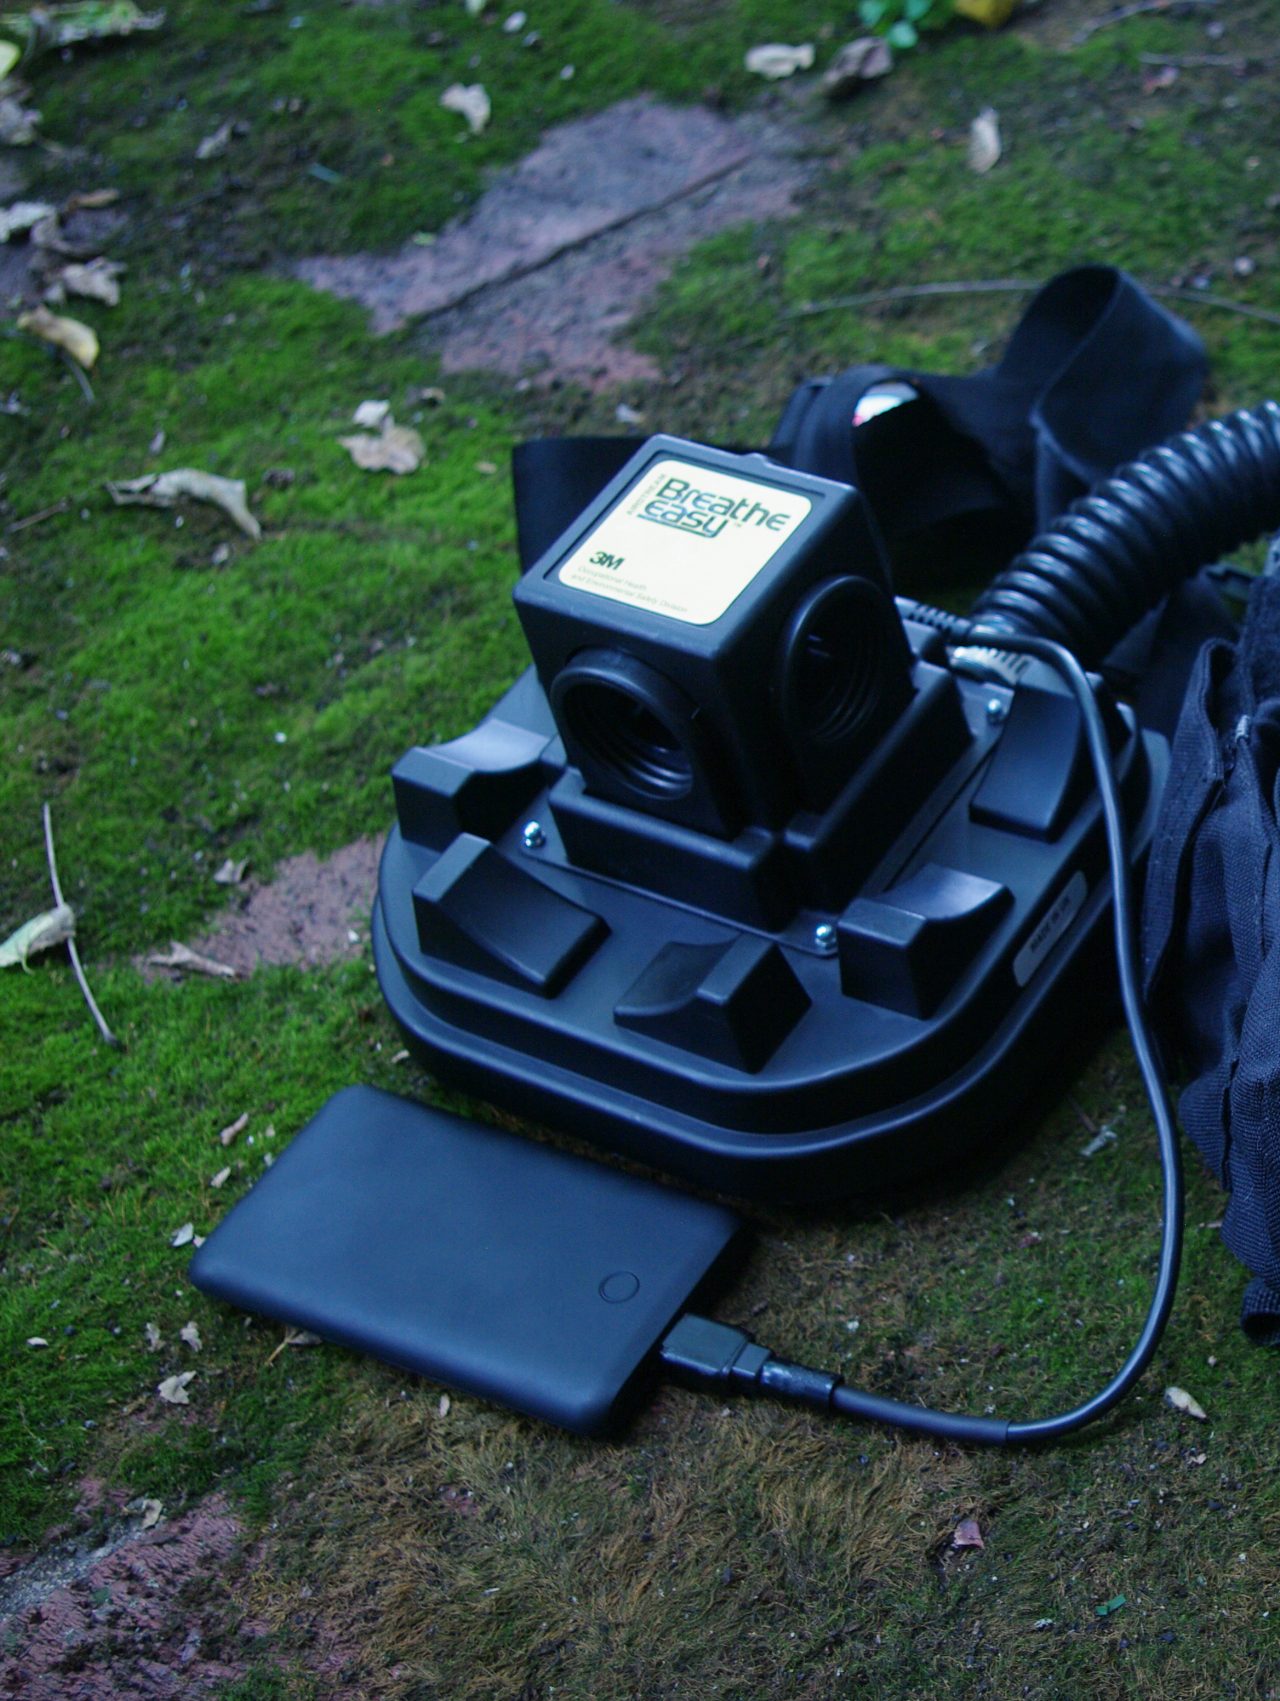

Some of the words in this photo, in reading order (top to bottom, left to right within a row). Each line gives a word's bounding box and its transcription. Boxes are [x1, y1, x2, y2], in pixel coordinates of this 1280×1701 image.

[655, 477, 791, 532] Breathe
[589, 551, 625, 571] 3M
[578, 565, 624, 584] Occupational
[625, 579, 647, 591] Health
[637, 592, 657, 605] Safety
[659, 599, 688, 612] Division
